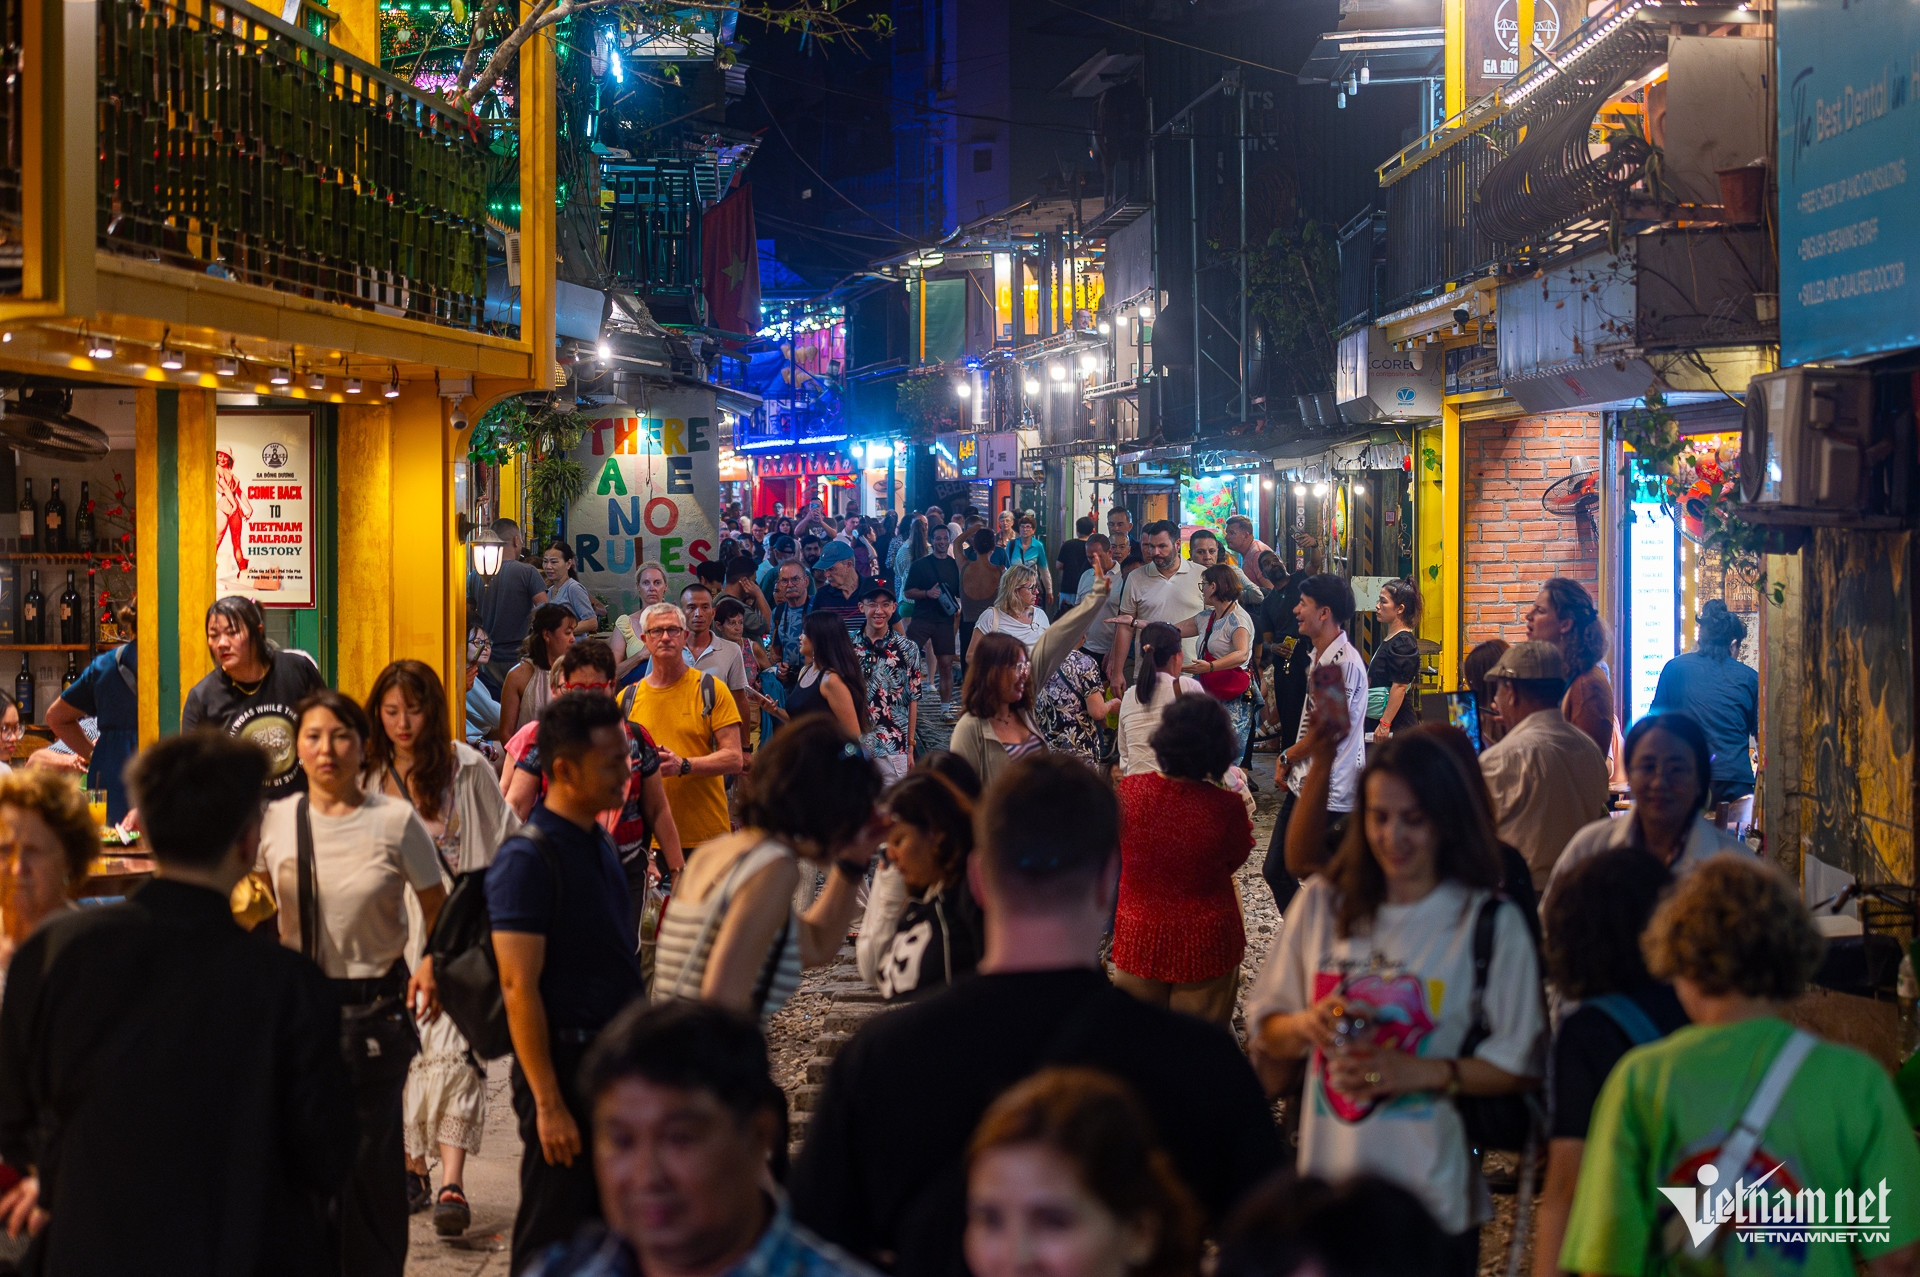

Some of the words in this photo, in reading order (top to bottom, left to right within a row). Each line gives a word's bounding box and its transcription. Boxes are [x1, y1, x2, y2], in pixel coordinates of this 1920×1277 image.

[1483, 59, 1498, 74] GA
[1815, 98, 1842, 143] Best
[1844, 64, 1888, 132] Dental
[585, 417, 711, 456] THERE
[596, 456, 694, 496] ARE
[248, 485, 275, 500] COME
[277, 485, 302, 500] BACK
[270, 505, 281, 518] TO
[608, 496, 679, 536] NO
[249, 522, 302, 532] VIETNAM
[249, 535, 302, 544] RAILROAD
[248, 547, 302, 556] HISTORY
[256, 704, 283, 714] WHILE
